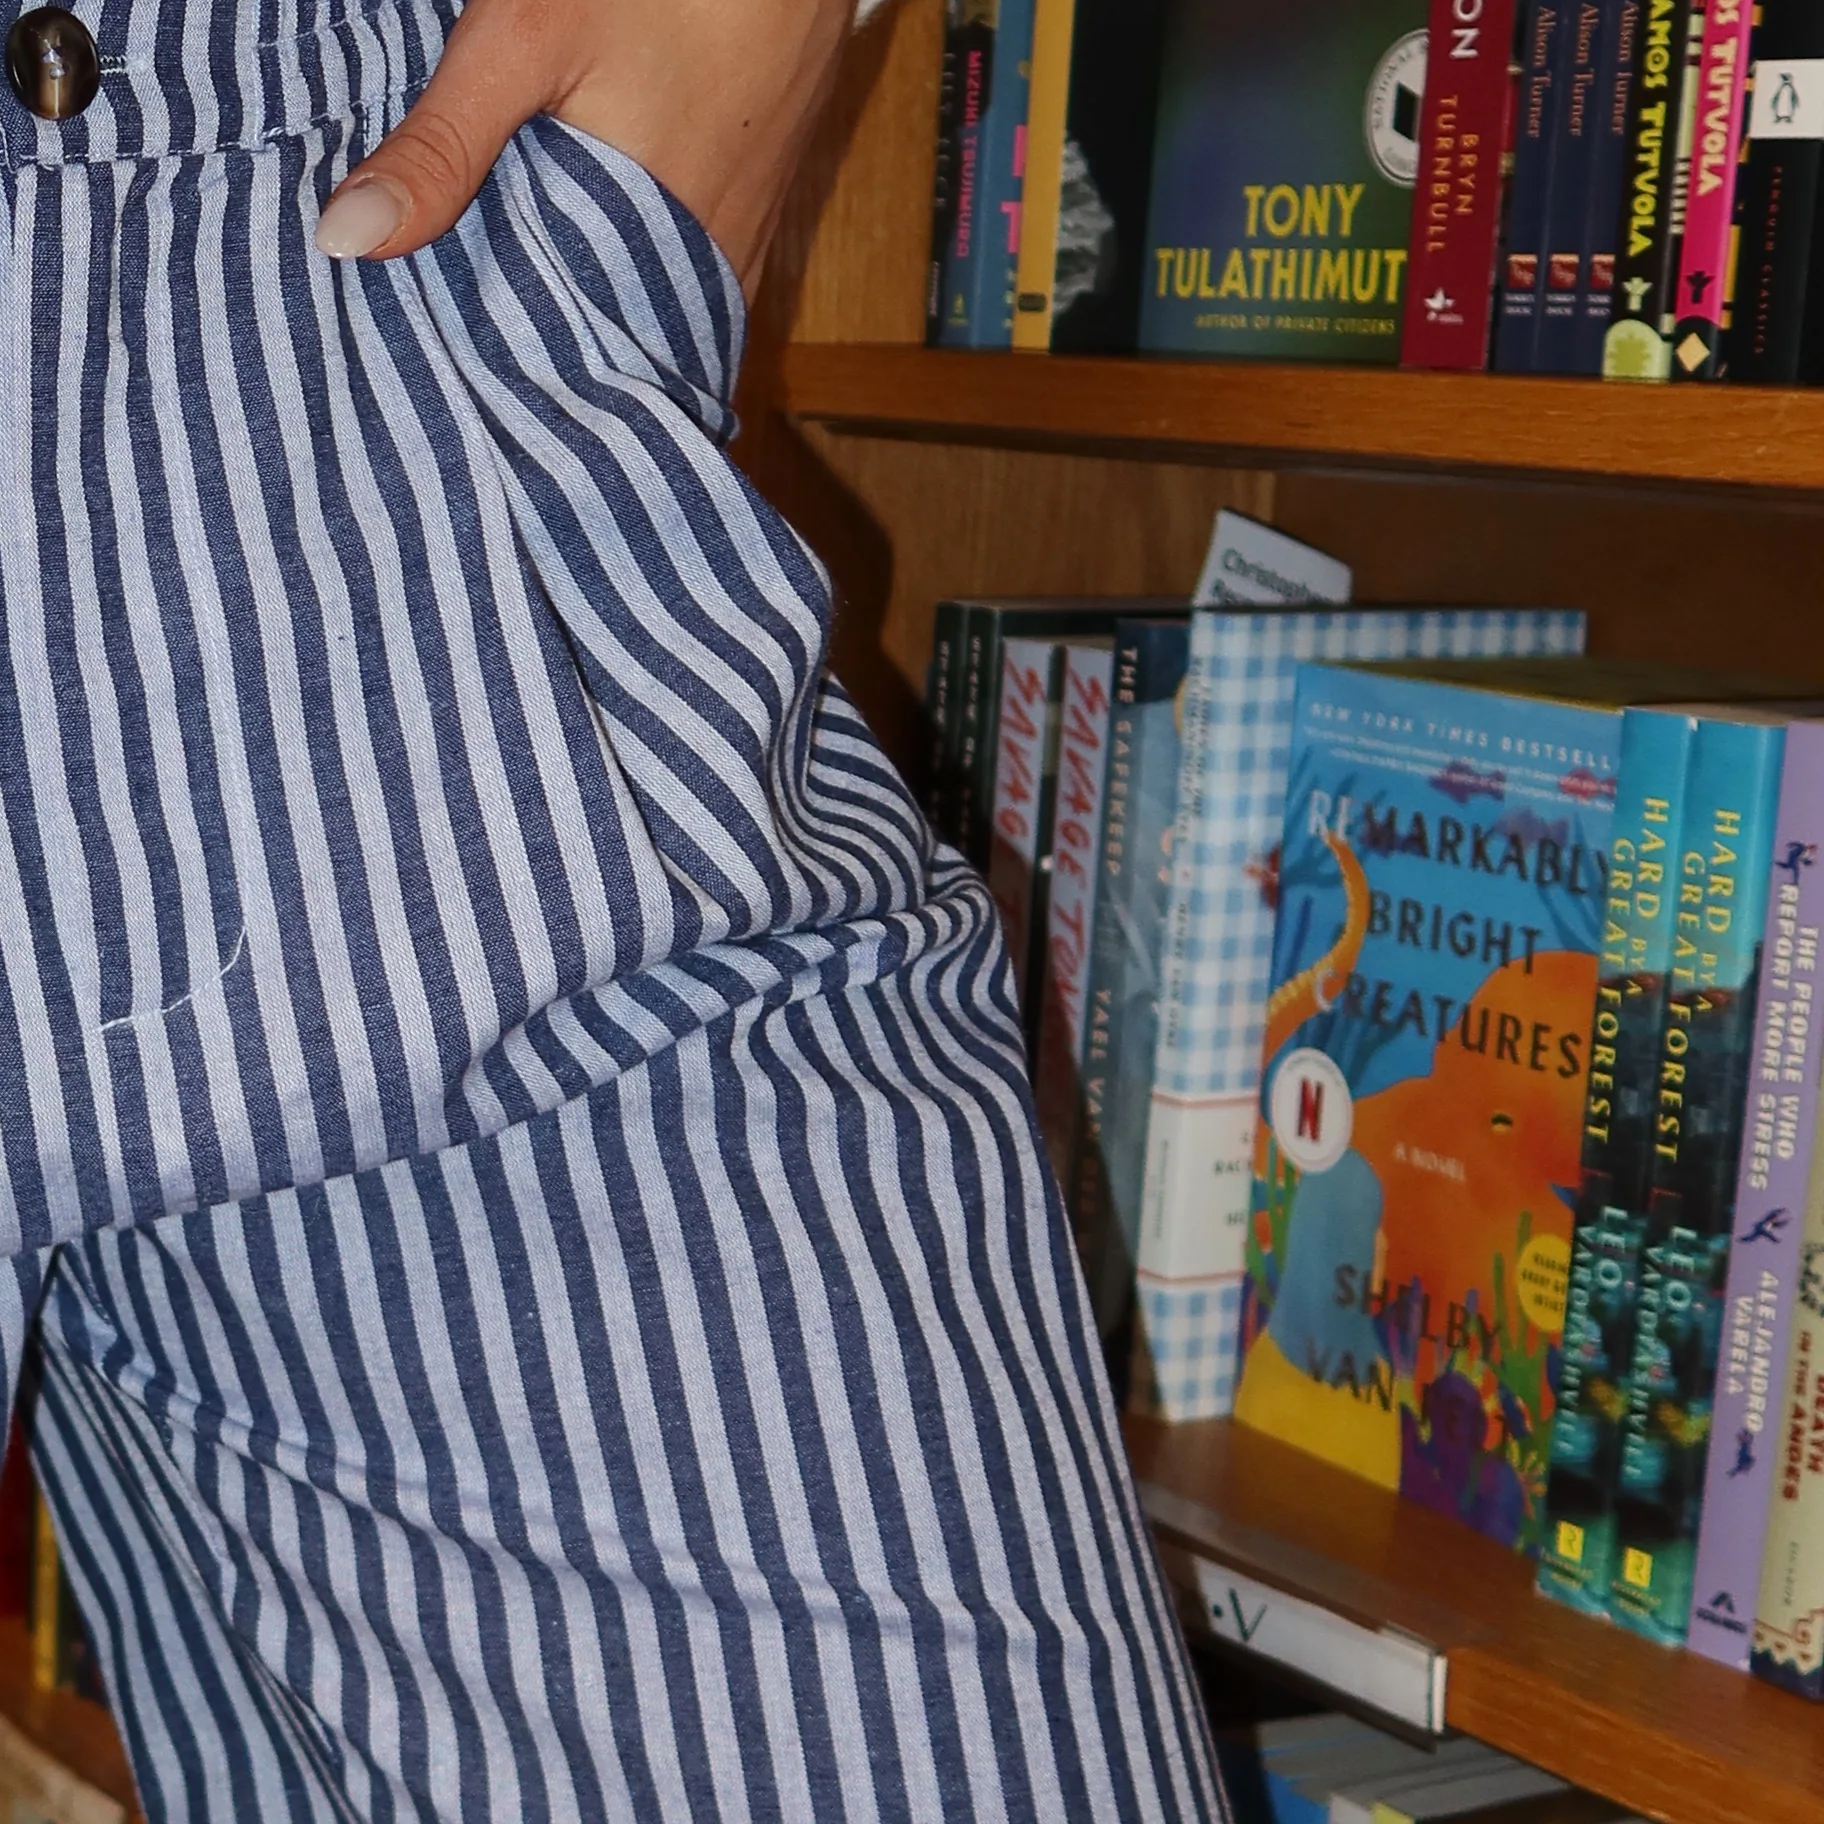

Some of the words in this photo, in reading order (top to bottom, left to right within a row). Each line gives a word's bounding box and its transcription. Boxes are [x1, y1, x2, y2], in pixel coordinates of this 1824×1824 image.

[1242, 181, 1366, 240] TONY
[1426, 94, 1459, 253] TURNBULL
[1455, 132, 1480, 216] BRYN
[1154, 247, 1409, 306] TULATHIMUT
[1118, 646, 1140, 705] THE
[1427, 722, 1489, 748] TIMES
[1502, 735, 1612, 771] BESTSELL
[1105, 718, 1132, 877] SAFEKEEP
[1602, 837, 1637, 973] GREAT
[1634, 796, 1670, 920] HARD
[1704, 807, 1742, 936] HARD
[1368, 889, 1543, 977] BRIGHT
[1672, 850, 1706, 987] GREAT
[1771, 881, 1800, 991] REPORT
[1795, 924, 1819, 973] THE
[1313, 967, 1585, 1079] CREATURES
[1585, 986, 1623, 1146] FOREST
[1761, 1001, 1789, 1083] MORE
[1785, 981, 1814, 1085] PEOPLE
[1654, 1000, 1692, 1165] FOREST
[1776, 1094, 1801, 1162] WHO
[1750, 1091, 1777, 1192] STRESS
[1592, 1205, 1630, 1290] LEO
[1663, 1226, 1699, 1312] LEO
[1726, 1295, 1754, 1396] VARELA
[1745, 1268, 1780, 1435] ALEJANDRO
[1229, 1587, 1268, 1644] V
